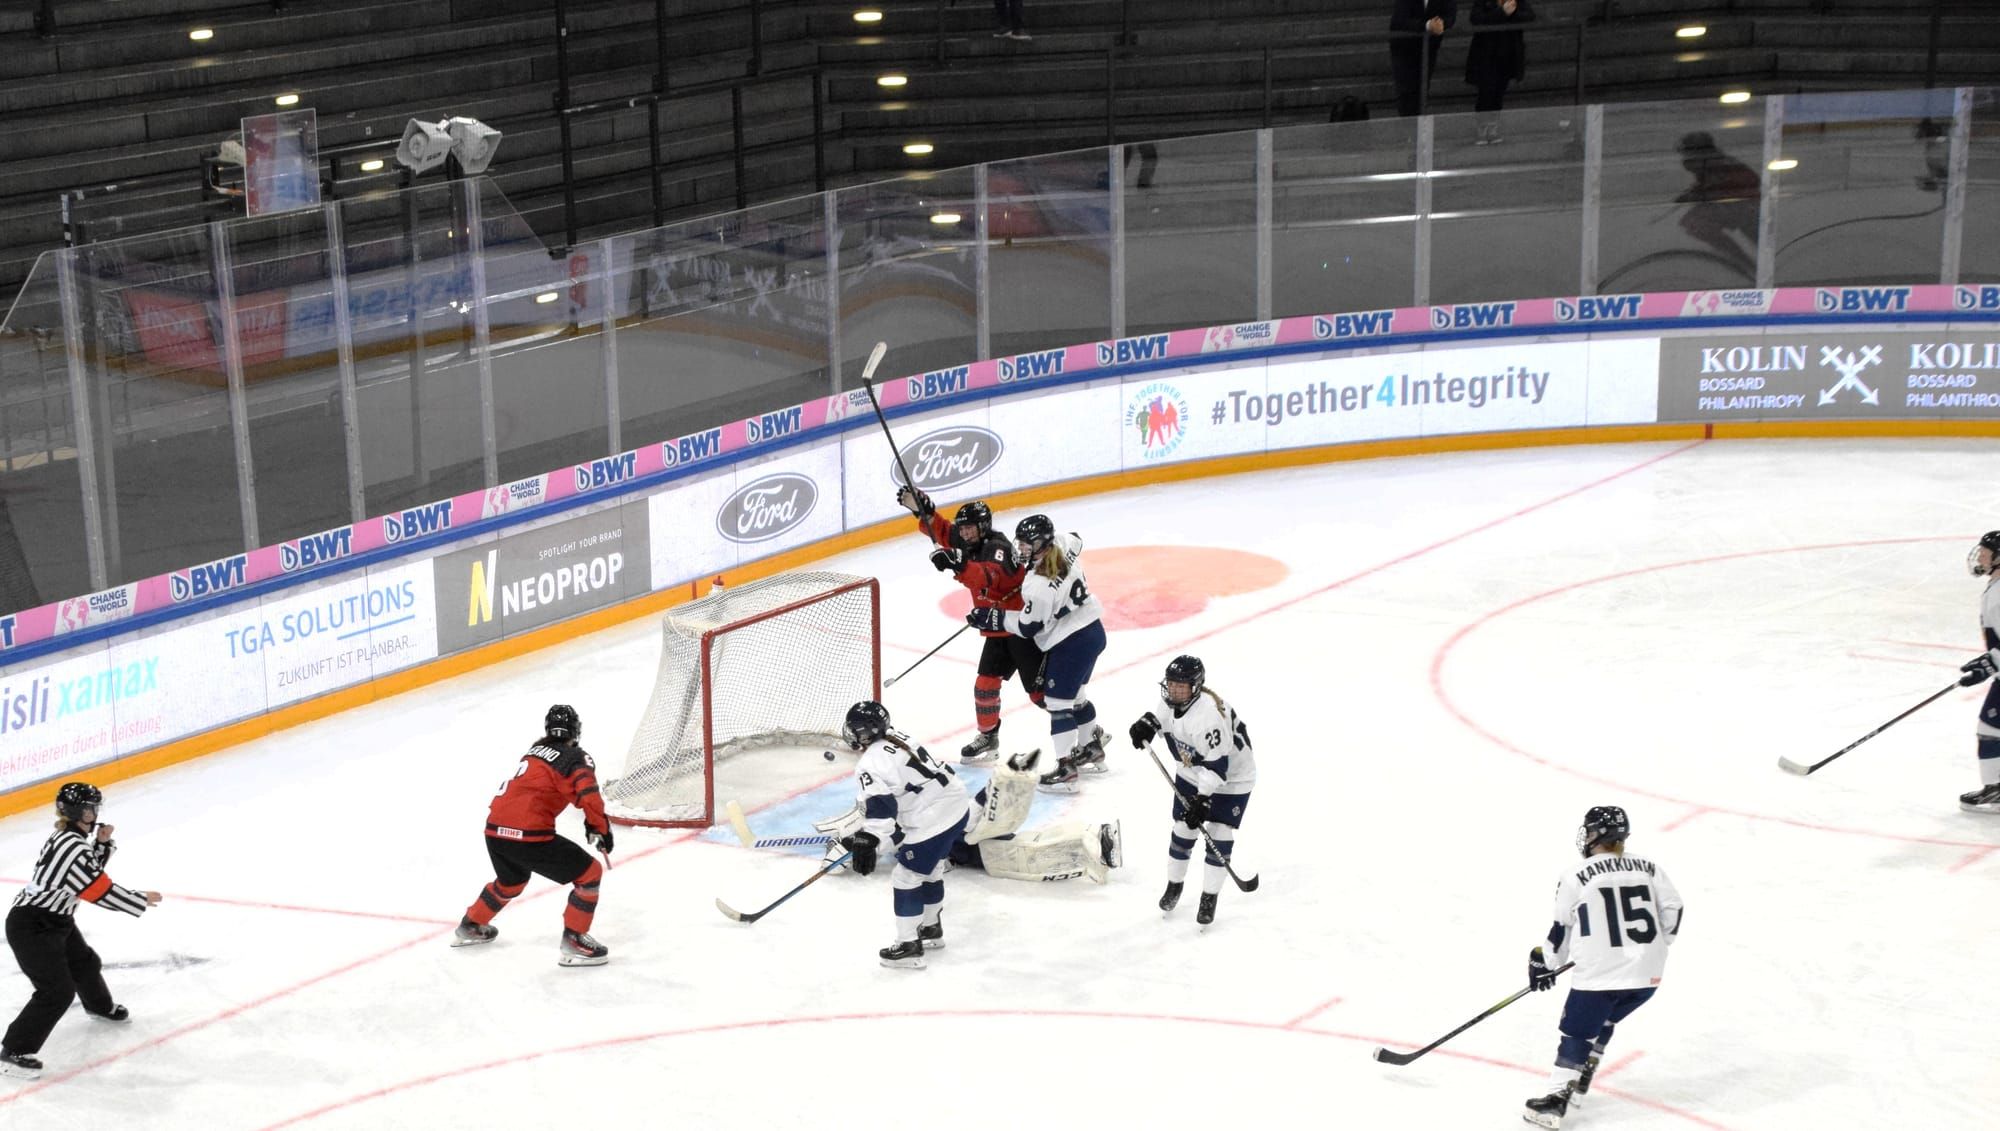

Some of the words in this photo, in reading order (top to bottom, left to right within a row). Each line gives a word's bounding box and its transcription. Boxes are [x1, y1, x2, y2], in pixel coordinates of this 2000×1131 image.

[1577, 295, 1642, 320] BWT
[1841, 288, 1911, 311] BWT
[1235, 323, 1270, 333] CHANGE
[1334, 310, 1395, 337] BWT
[1453, 303, 1515, 329] BWT
[1116, 335, 1169, 363] BWT
[1243, 331, 1270, 340] WORLD
[1015, 350, 1065, 379] BWT
[1701, 345, 1808, 373] KOLIN
[923, 367, 969, 398] BWT
[1699, 377, 1765, 392] BOSSARD
[1907, 374, 1977, 388] BOSSARD
[1211, 366, 1550, 426] #Together4Integrity
[1698, 394, 1806, 410] PHILANTHROPY
[760, 408, 802, 440] BWT
[678, 429, 721, 463] BWT
[591, 453, 636, 488] BWT
[911, 437, 979, 484] Ford
[510, 479, 540, 492] CHANGE
[517, 488, 540, 499] WORLD
[402, 501, 453, 538] BWT
[736, 484, 799, 534] Ford
[299, 527, 352, 567] BWT
[538, 541, 576, 560] SPOTLIGHT
[579, 535, 597, 549] YOUR
[599, 528, 622, 542] BRAND
[190, 556, 247, 597] BWT
[502, 552, 623, 617] NEOPROP
[90, 589, 127, 606] CHANGE
[99, 598, 128, 612] WORLD
[225, 621, 275, 658] TGA
[283, 580, 415, 642] SOLUTIONS
[278, 656, 333, 687] ZUKUNFT
[337, 651, 353, 669] IST
[56, 656, 159, 720] xamax
[1205, 728, 1222, 750] 23
[860, 772, 874, 791] 13
[988, 787, 1001, 822] CCM
[754, 835, 832, 848] WARRIOR
[1041, 871, 1084, 882] CCM
[1598, 884, 1657, 947] 15
